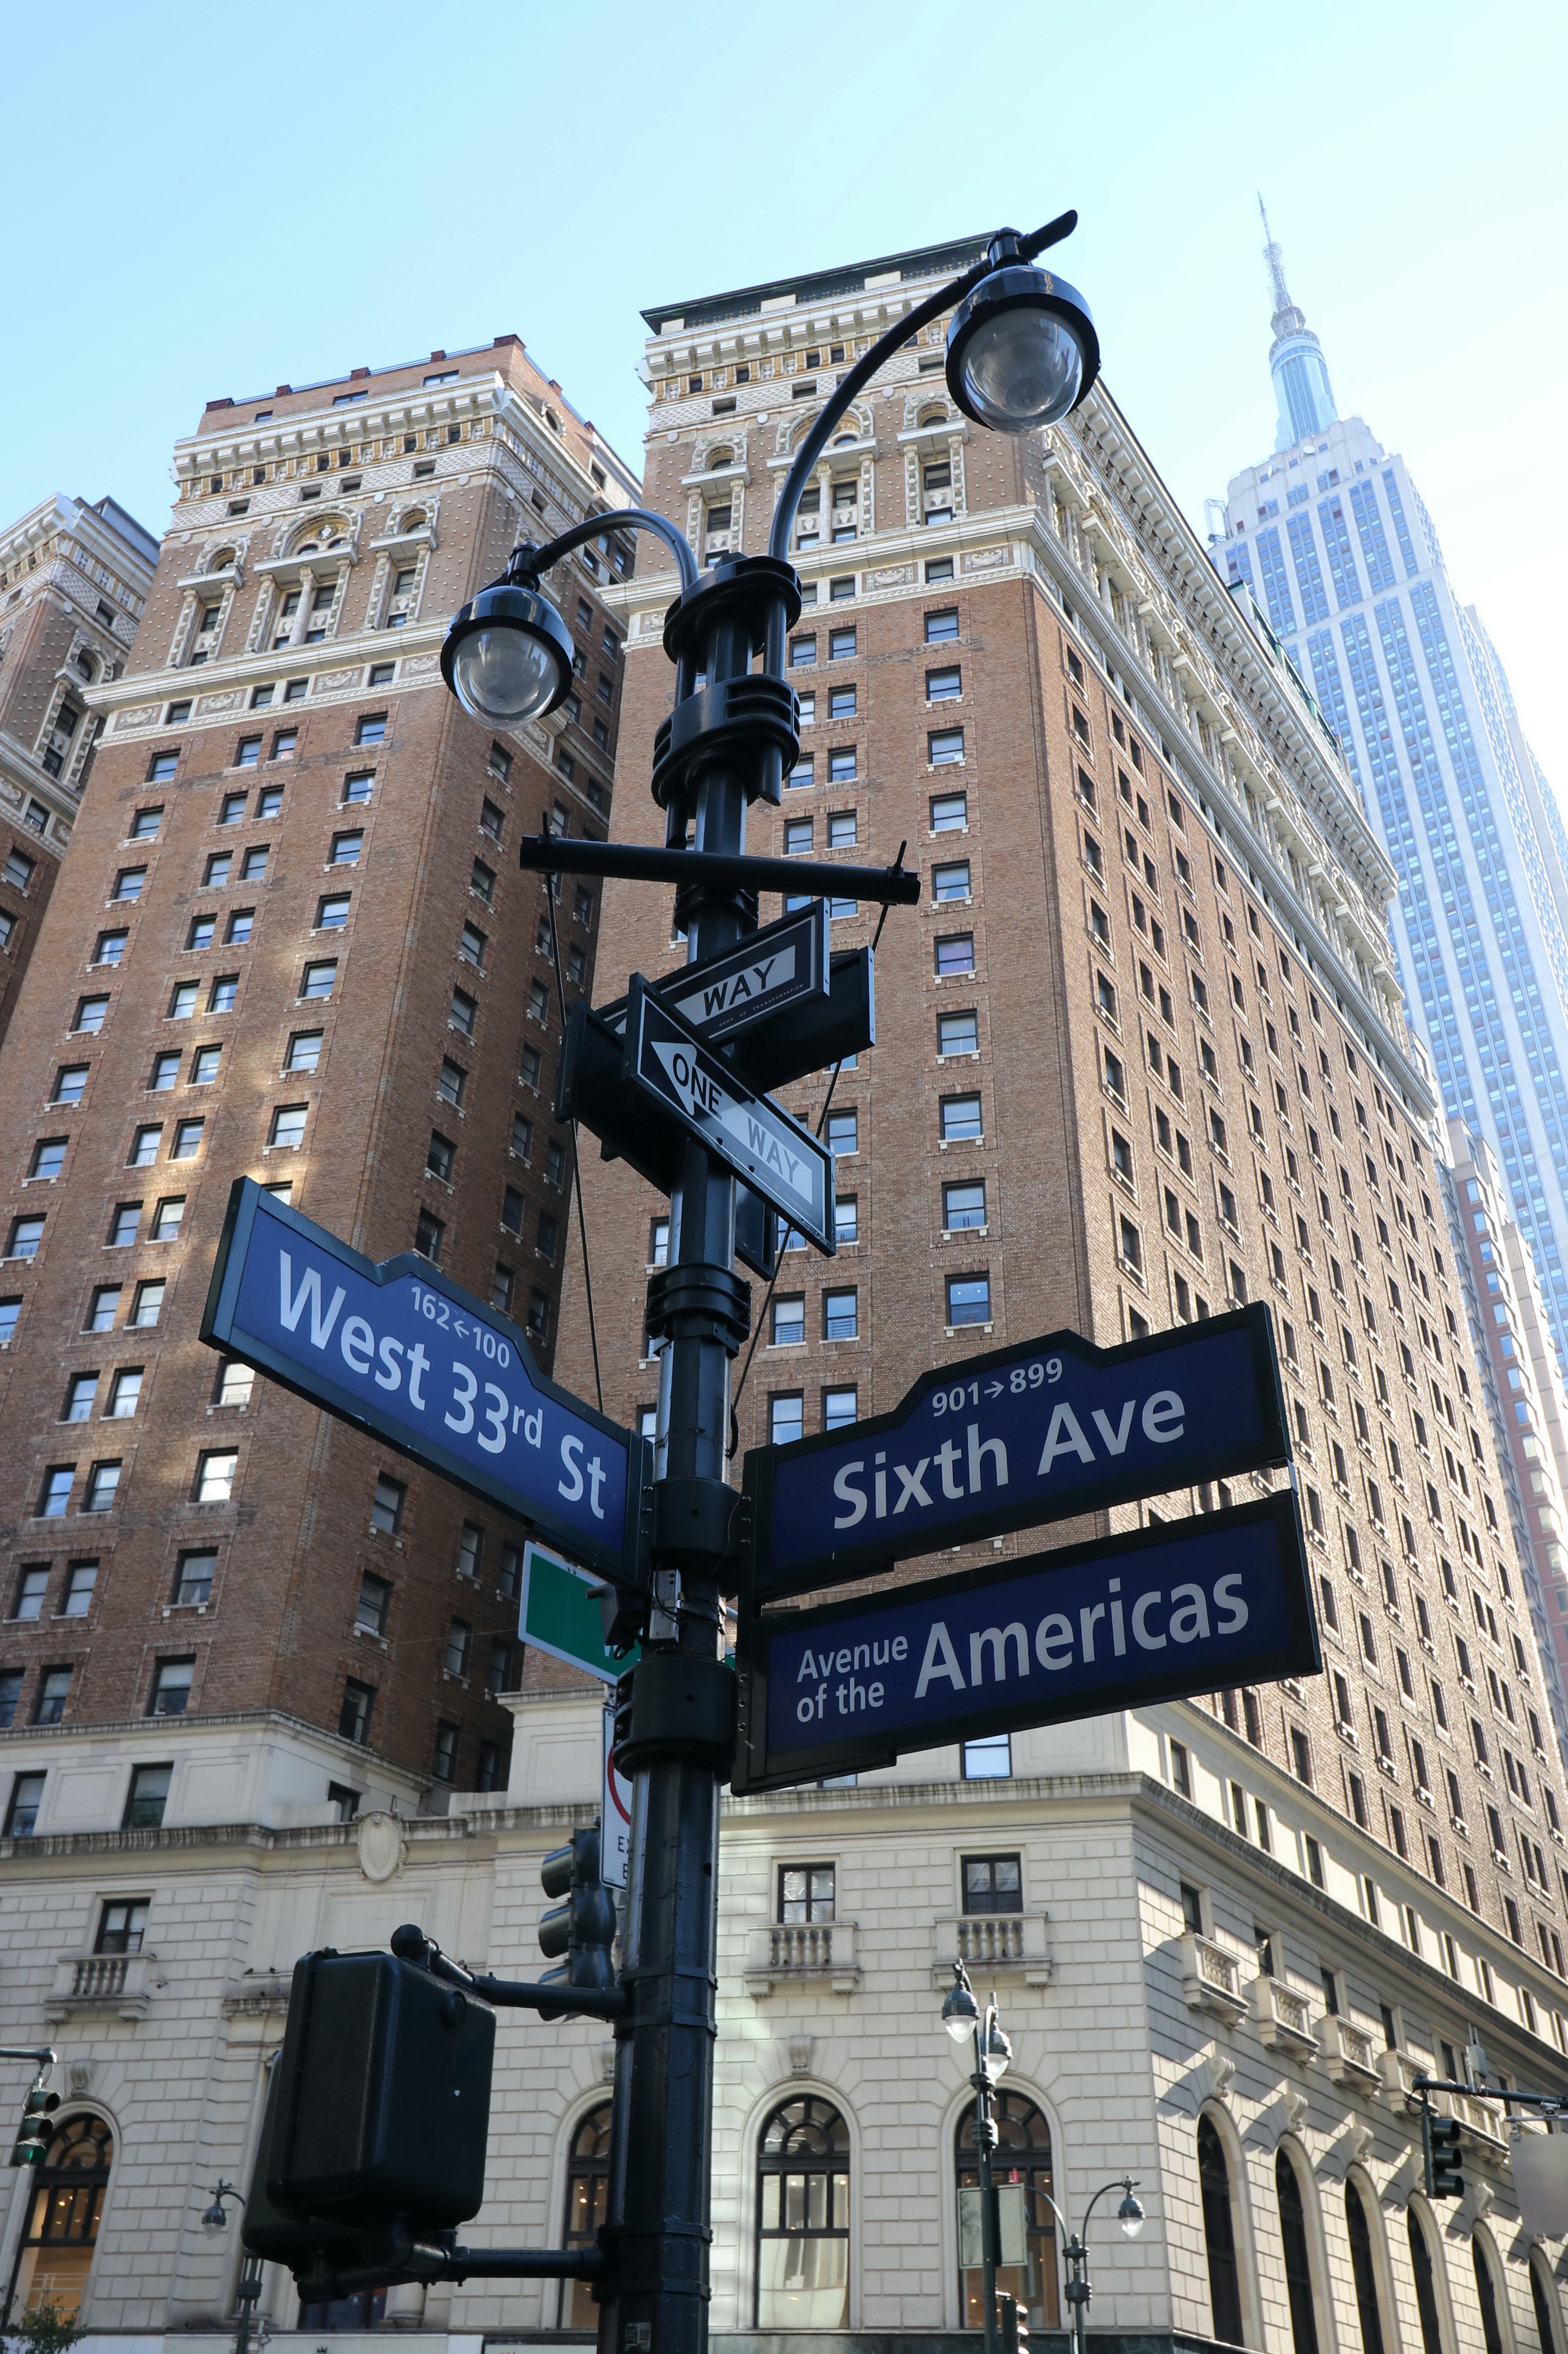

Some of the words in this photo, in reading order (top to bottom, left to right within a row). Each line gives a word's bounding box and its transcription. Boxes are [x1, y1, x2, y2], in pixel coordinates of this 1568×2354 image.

[704, 958, 776, 1017] WAY
[719, 1018, 734, 1027] DEPT
[753, 984, 804, 1010] TRANSPORTATION
[672, 1053, 722, 1121] ONE
[748, 1117, 799, 1184] WAY
[411, 1286, 450, 1330] 162
[473, 1327, 510, 1368] 100
[280, 1250, 430, 1411] West
[444, 1361, 543, 1453] 33rd
[558, 1434, 606, 1519] St
[932, 1382, 978, 1417] 901
[1010, 1358, 1063, 1393] 899
[833, 1423, 1008, 1529] Sixth
[1037, 1390, 1185, 1475] Ave
[797, 1636, 908, 1683] Avenue
[914, 1574, 1248, 1698] Americas
[797, 1683, 827, 1722] of
[836, 1677, 884, 1714] the
